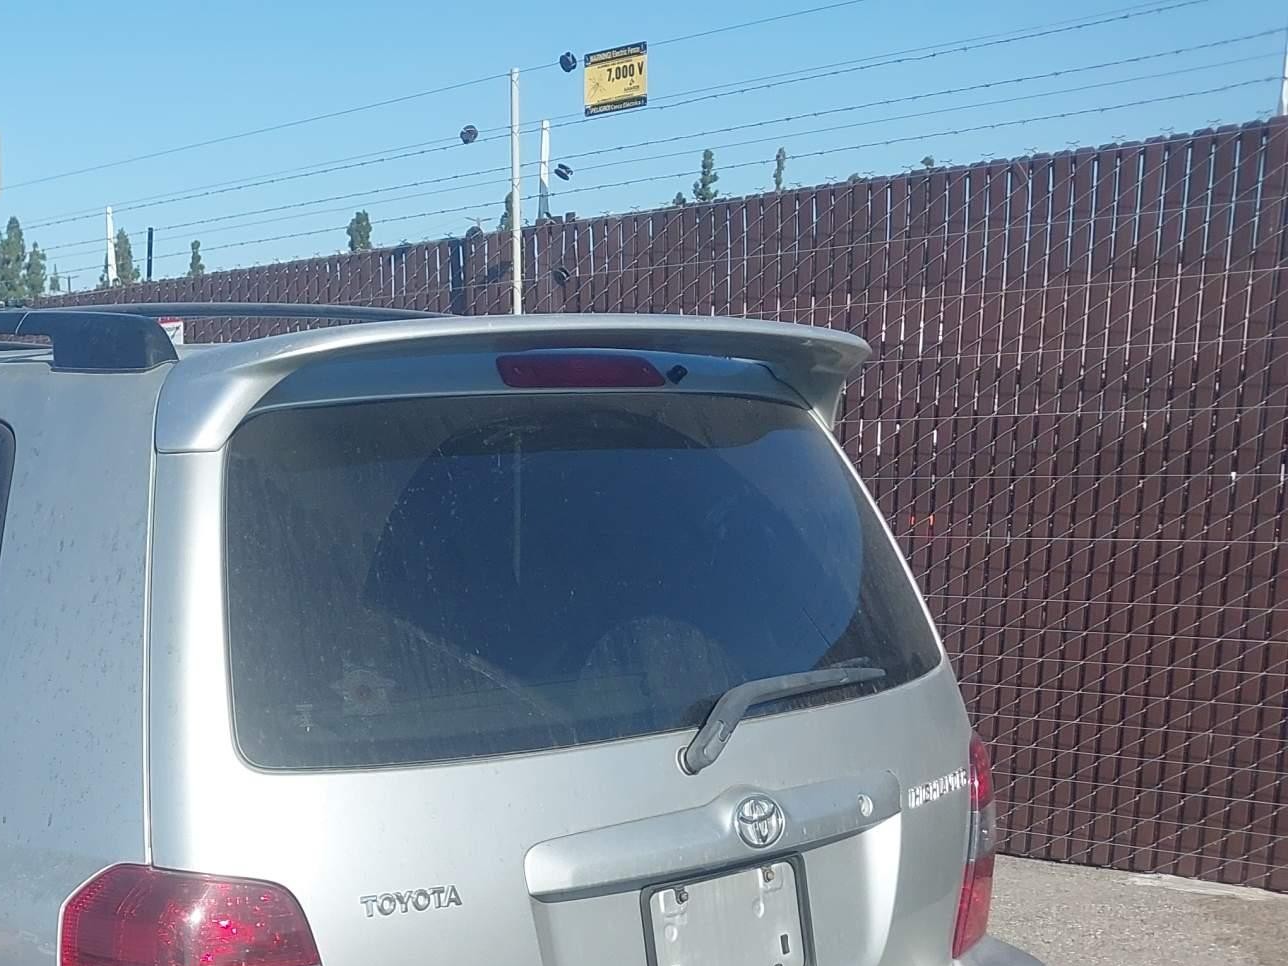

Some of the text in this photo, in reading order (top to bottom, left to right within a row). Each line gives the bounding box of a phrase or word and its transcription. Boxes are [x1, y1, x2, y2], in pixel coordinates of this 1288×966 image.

[606, 63, 635, 83] 7,000
[637, 60, 644, 76] V
[359, 885, 463, 919] TOYOTA
